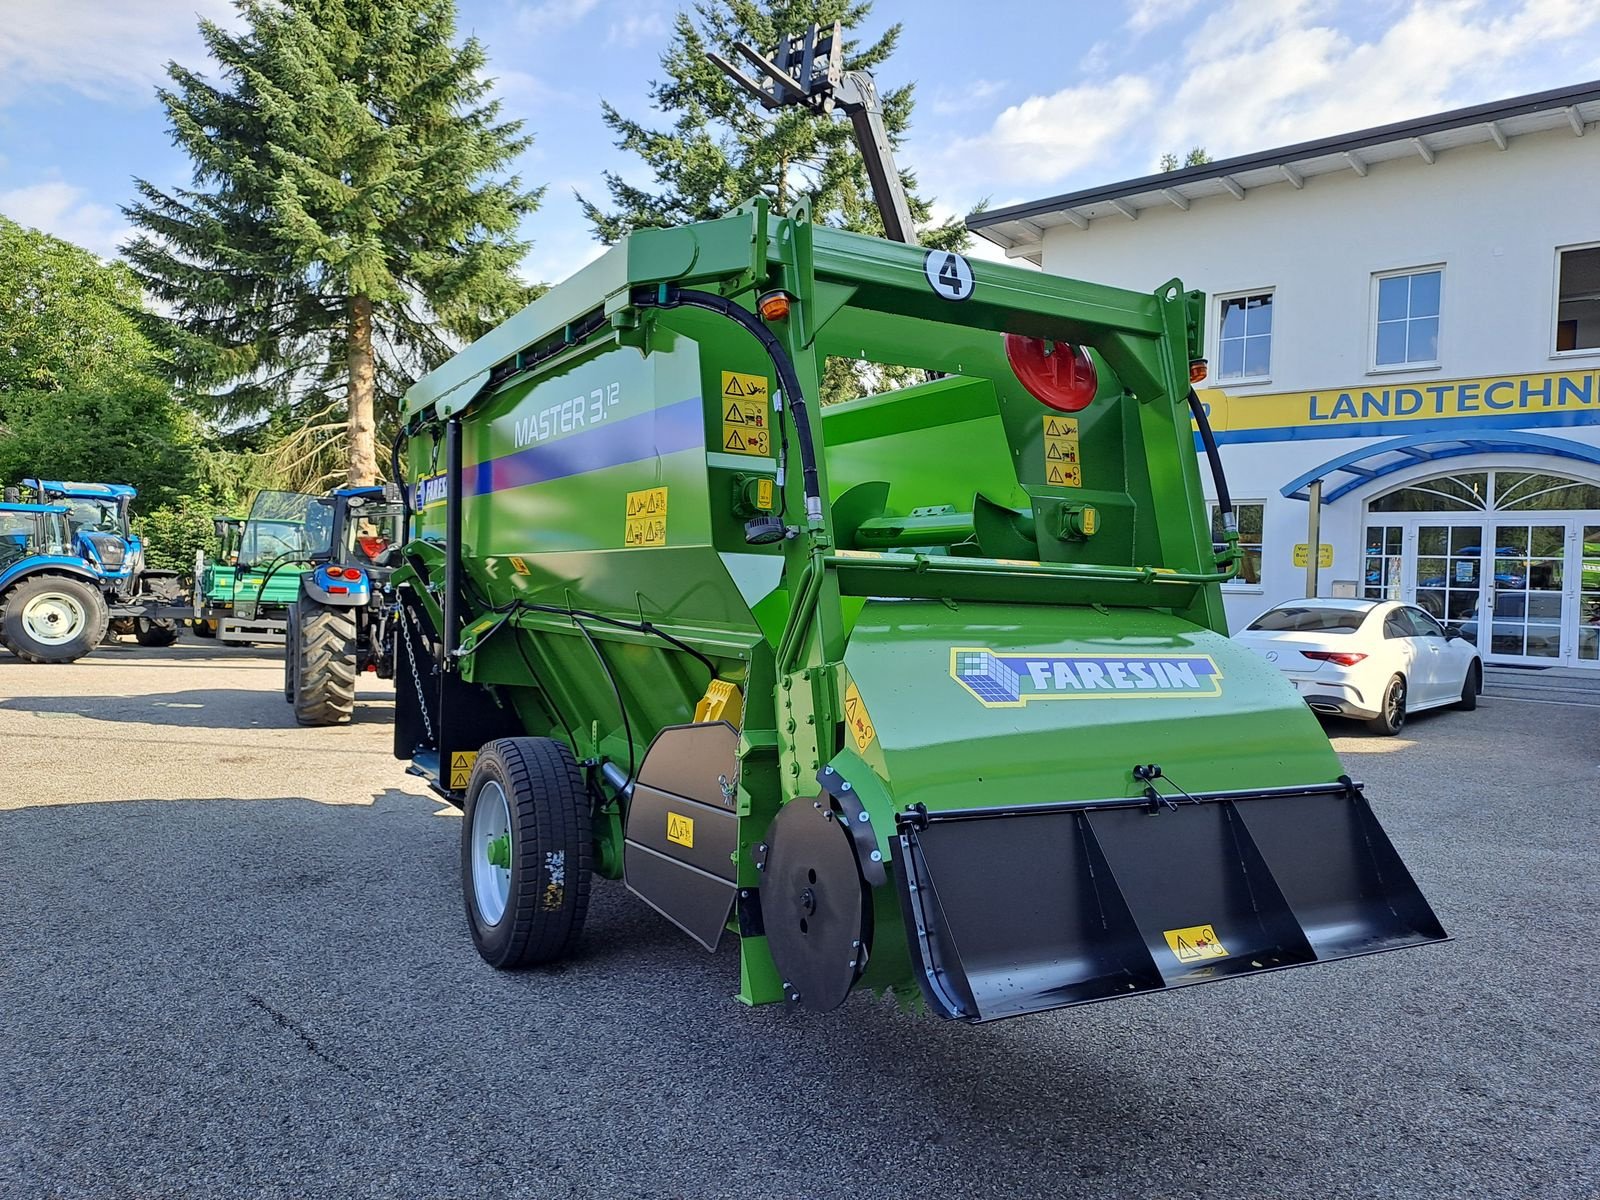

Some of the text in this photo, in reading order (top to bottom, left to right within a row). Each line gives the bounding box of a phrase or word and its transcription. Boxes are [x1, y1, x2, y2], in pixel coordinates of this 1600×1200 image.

[938, 253, 963, 296] 4
[1309, 375, 1600, 421] LANDTECHN
[514, 396, 585, 449] MASTER
[425, 476, 448, 502] FARES
[1025, 661, 1201, 690] FARESIN
